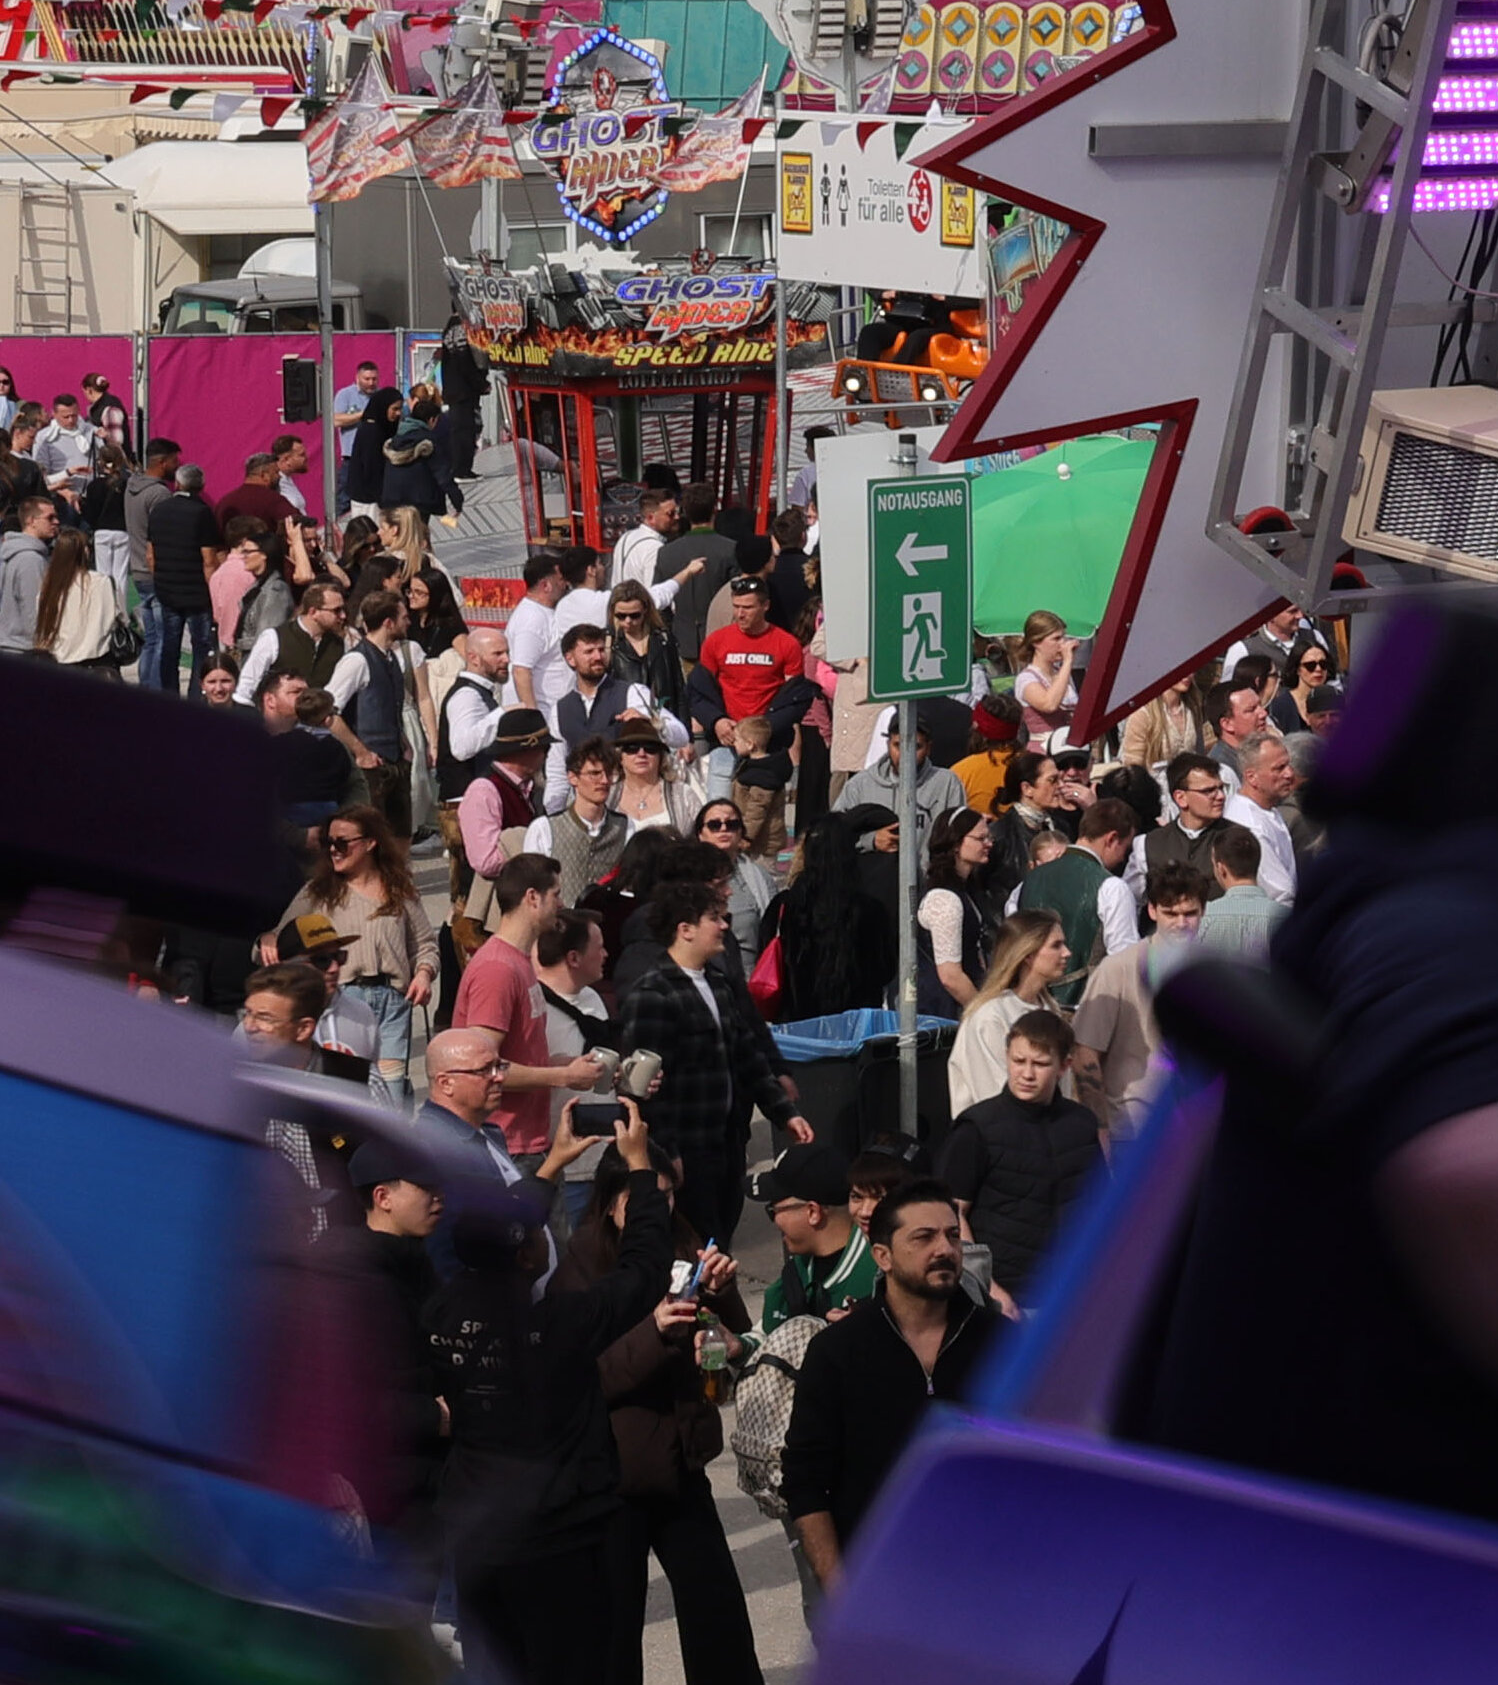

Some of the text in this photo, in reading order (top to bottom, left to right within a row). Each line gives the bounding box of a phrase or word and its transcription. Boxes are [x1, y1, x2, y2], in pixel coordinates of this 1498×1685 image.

[868, 178, 905, 197] Toiletten
[858, 197, 905, 223] für alle
[465, 278, 520, 301] GHOST
[617, 274, 777, 303] GHOST
[876, 488, 963, 512] NOTAUSGANG
[725, 653, 747, 665] JUST
